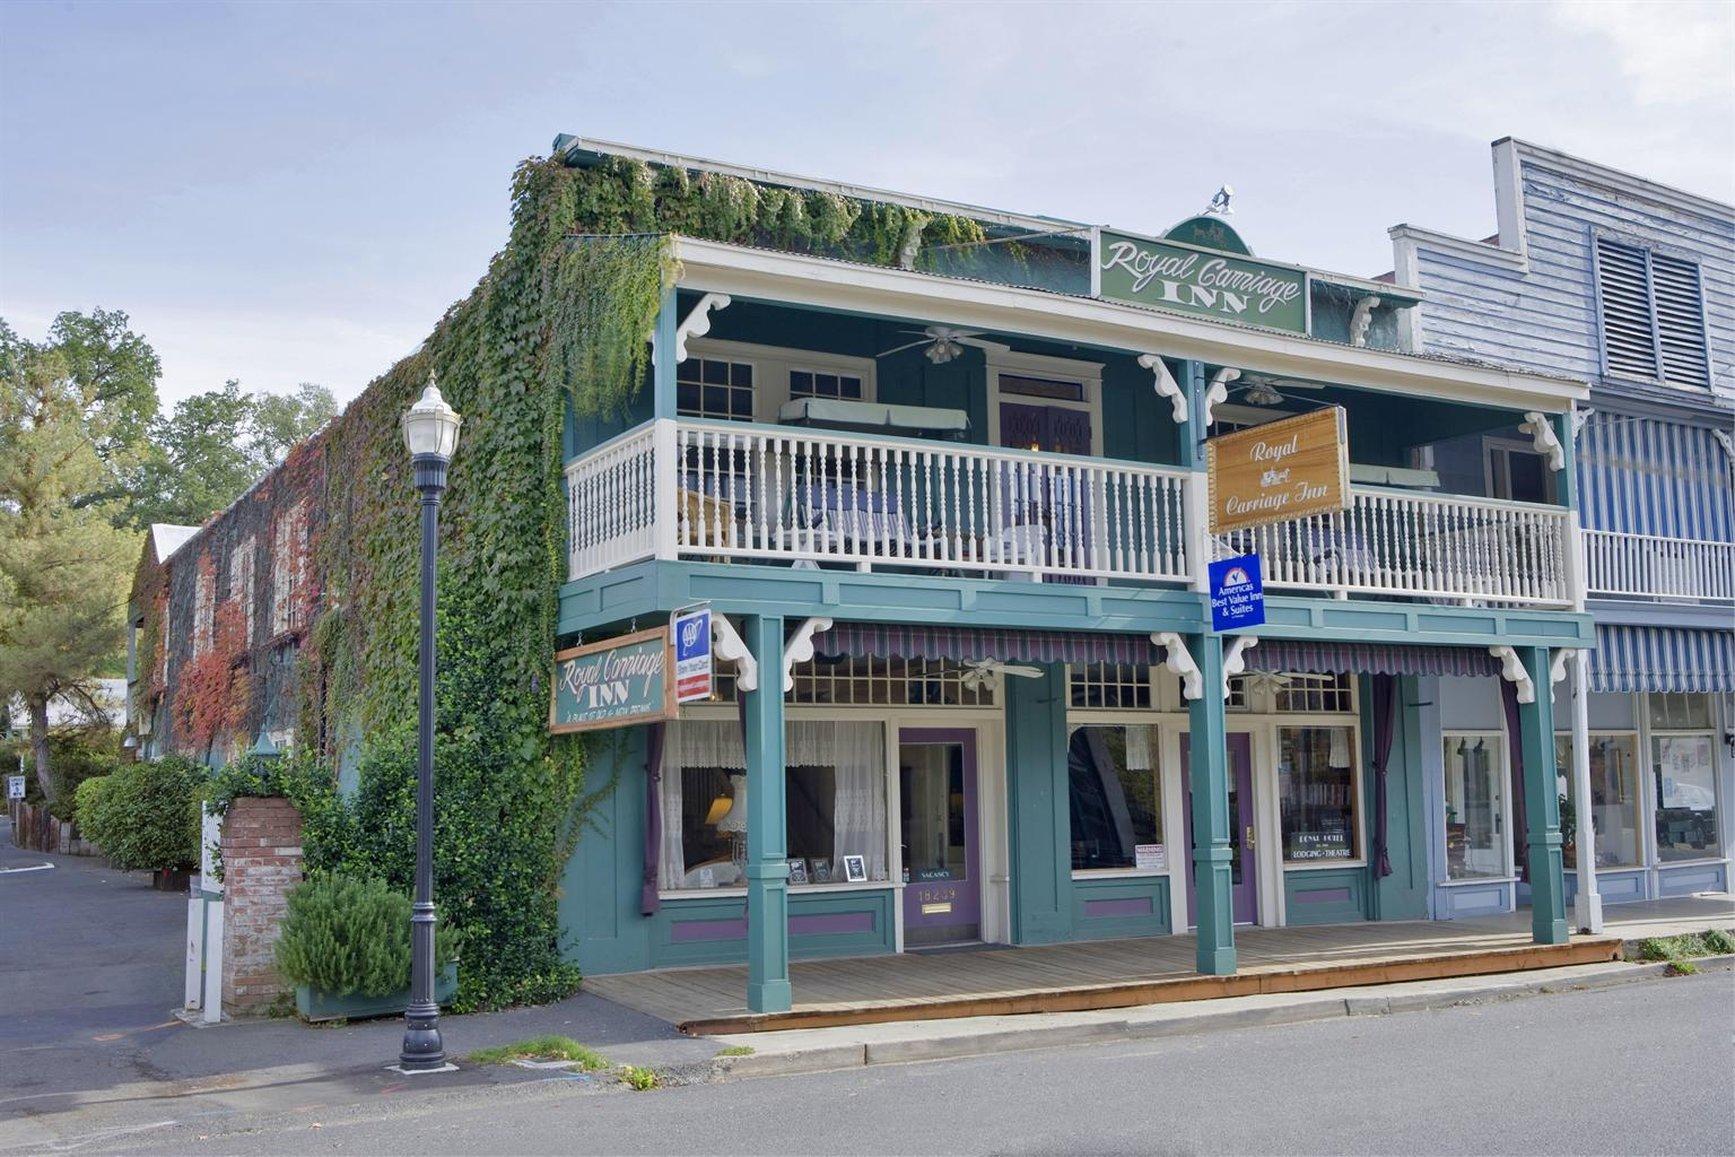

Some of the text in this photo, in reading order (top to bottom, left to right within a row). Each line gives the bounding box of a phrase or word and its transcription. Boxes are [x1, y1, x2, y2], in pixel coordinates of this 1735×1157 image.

[1101, 241, 1301, 314] Royal Carriage
[1158, 279, 1249, 314] INN
[1250, 434, 1298, 462] Royal
[1226, 481, 1328, 516] Carriage Inn
[1211, 597, 1228, 608] Best
[1228, 593, 1249, 604] Value
[1222, 607, 1229, 617] &
[1230, 604, 1254, 615] Suites
[559, 655, 603, 702] Royal
[603, 647, 665, 698] Carriage
[588, 679, 630, 709] INN
[1293, 848, 1351, 858] LODGING THEATRE
[921, 870, 950, 879] VACANCY
